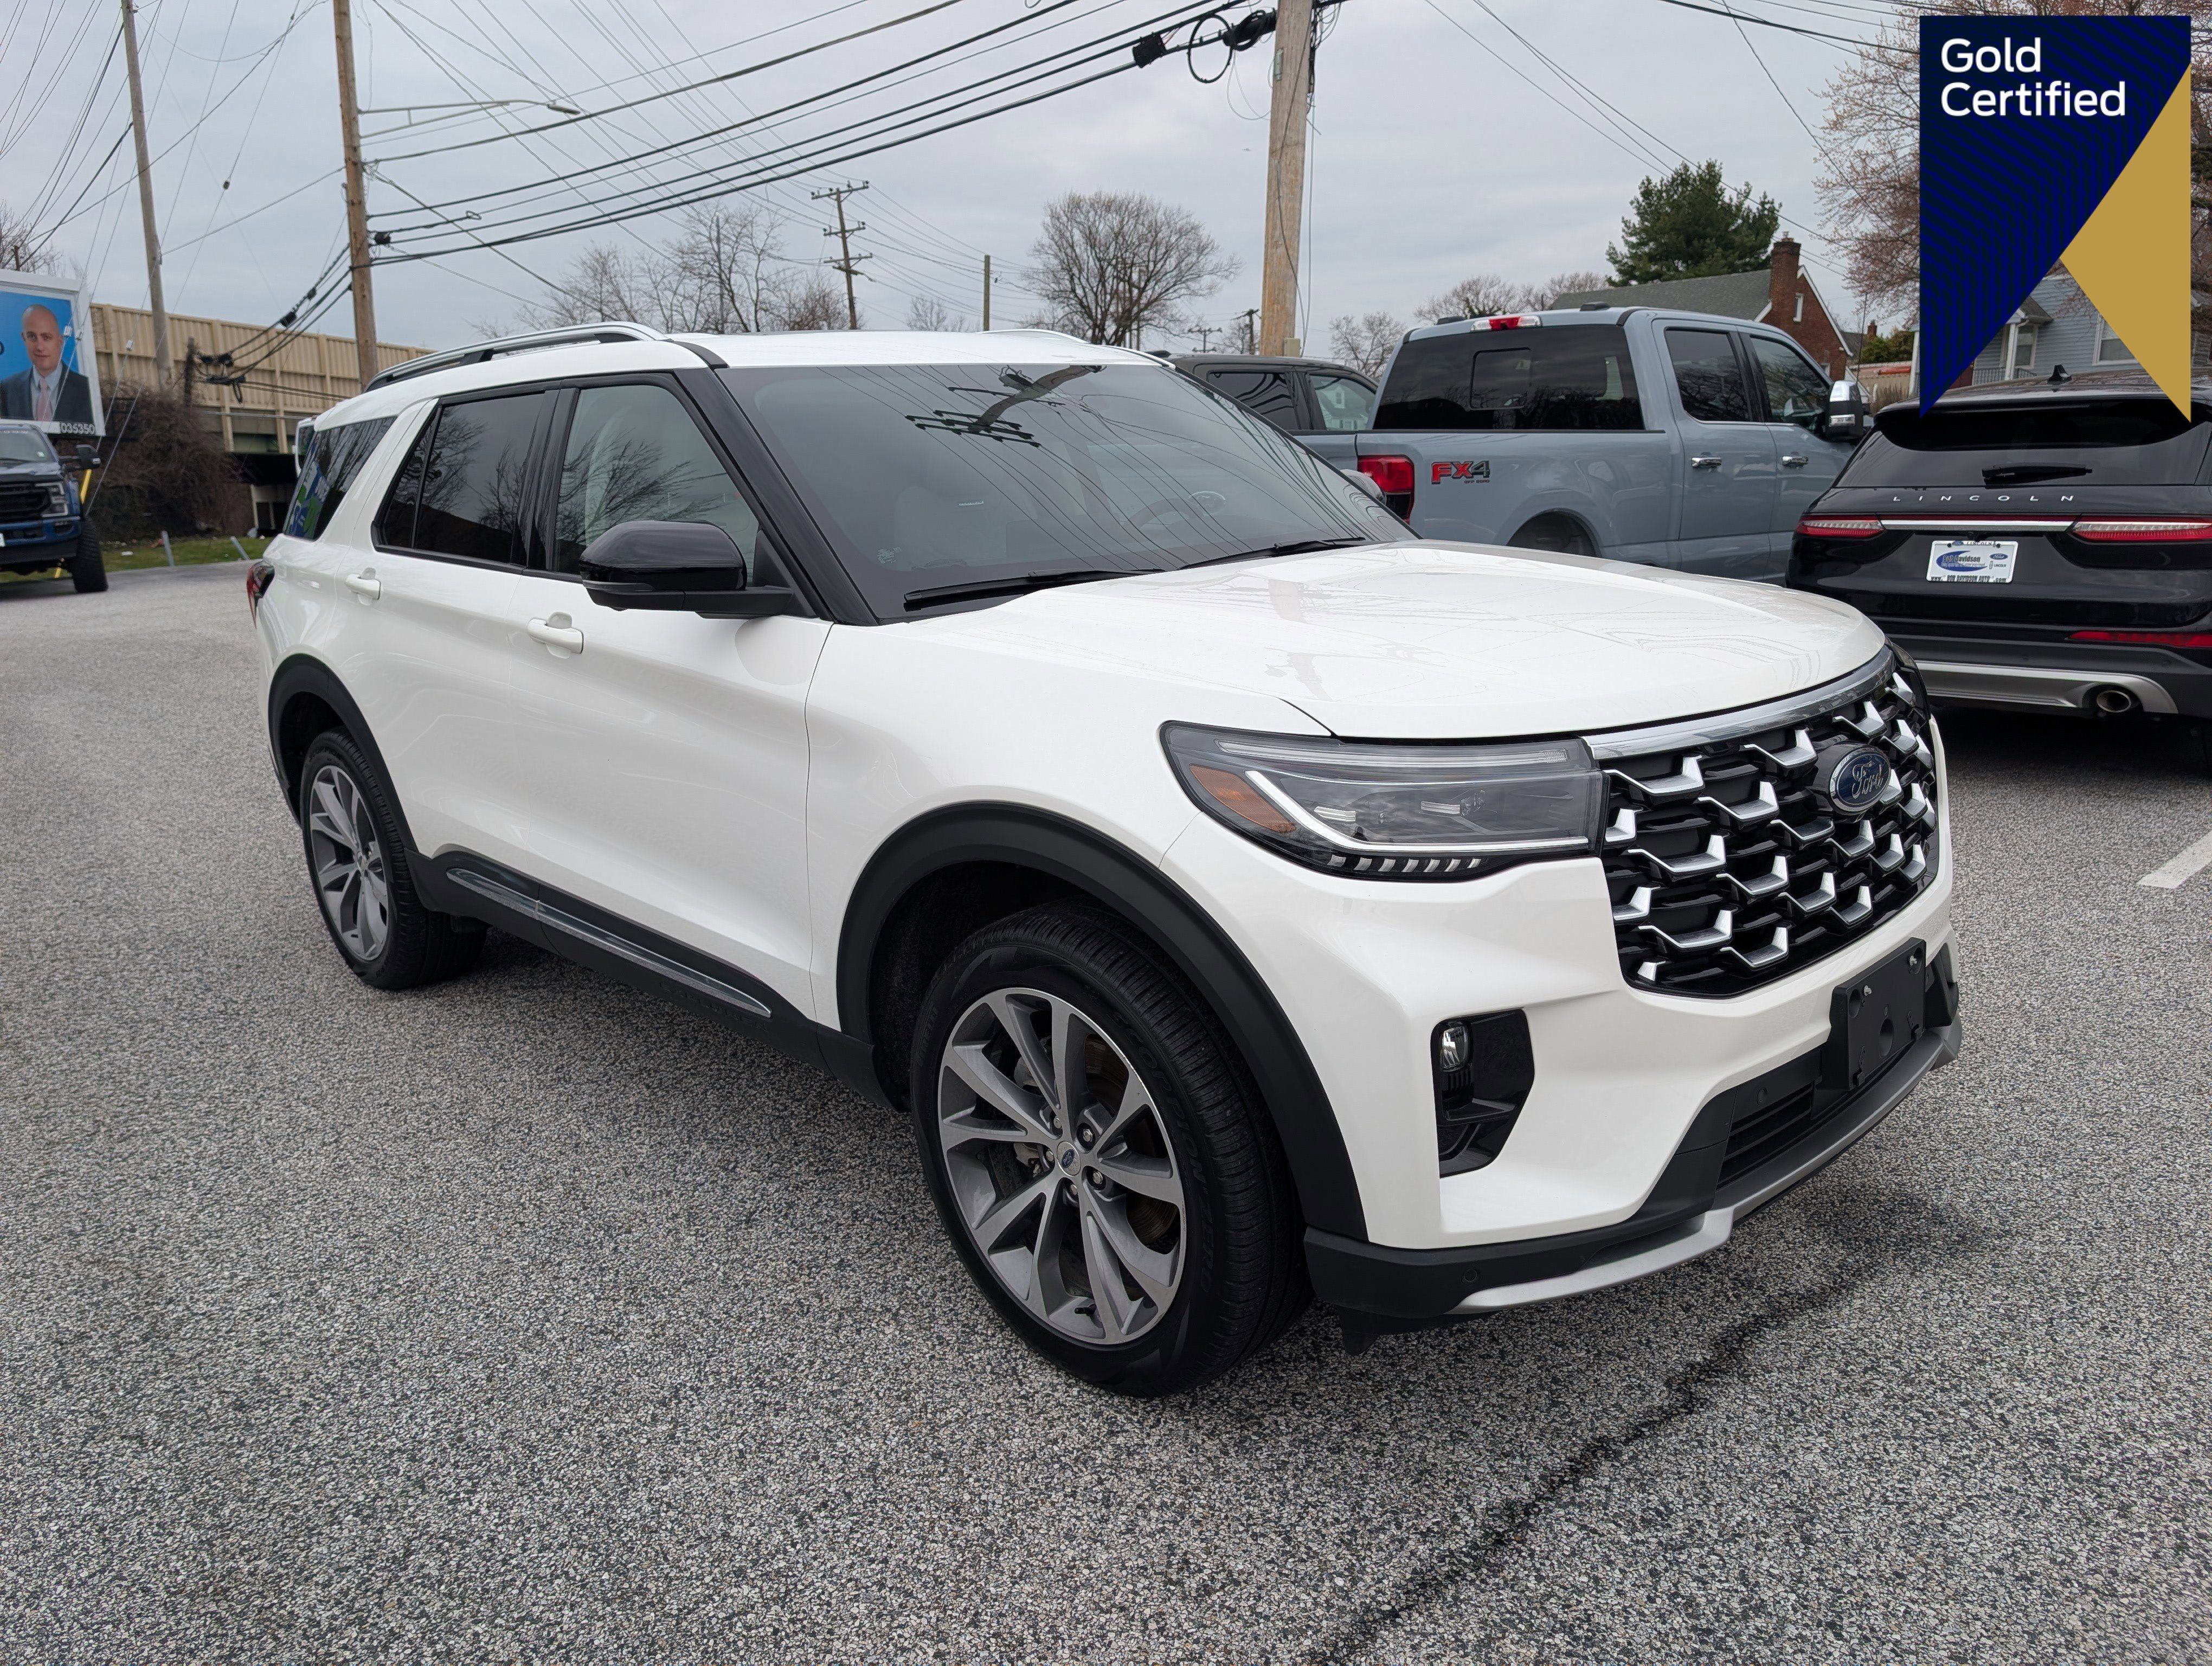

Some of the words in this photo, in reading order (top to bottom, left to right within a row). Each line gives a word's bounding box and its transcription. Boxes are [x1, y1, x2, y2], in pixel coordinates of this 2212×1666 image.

[61, 422, 95, 435] 035350
[1431, 460, 1490, 485] FX4
[1955, 555, 1981, 563] Davidson
[1851, 760, 1883, 799] Ford
